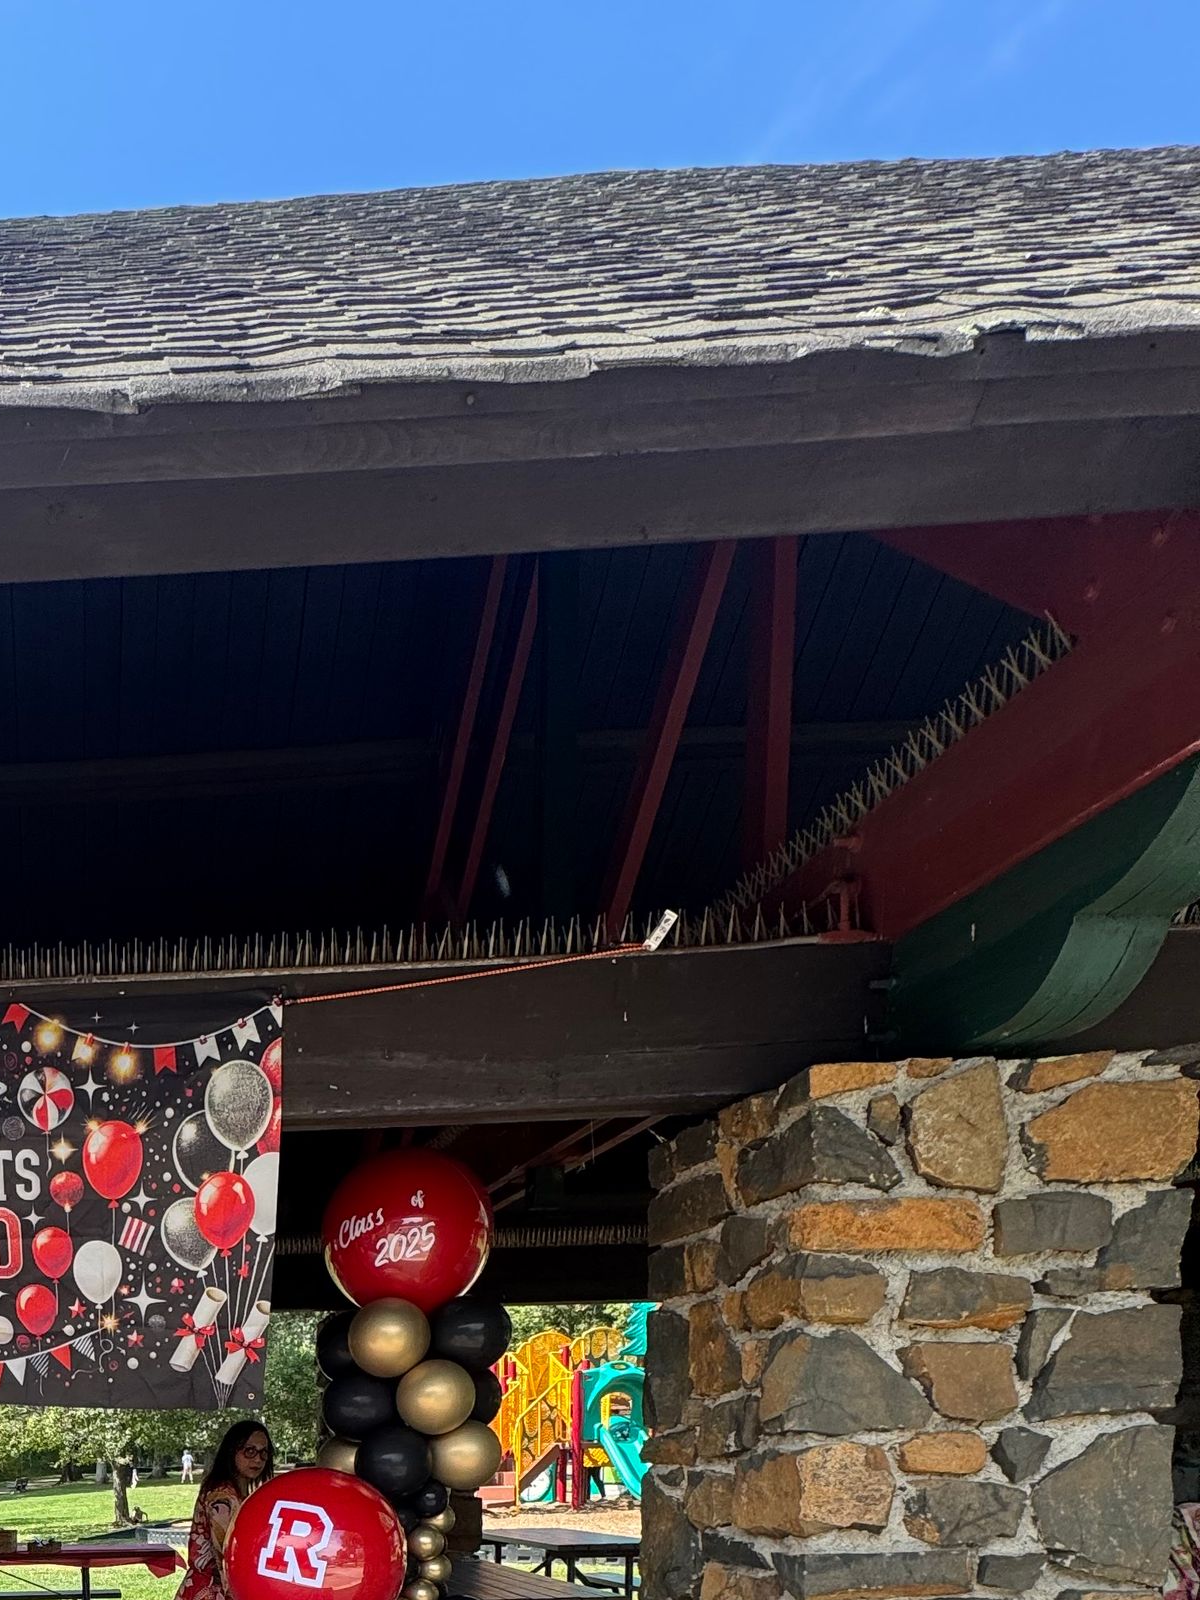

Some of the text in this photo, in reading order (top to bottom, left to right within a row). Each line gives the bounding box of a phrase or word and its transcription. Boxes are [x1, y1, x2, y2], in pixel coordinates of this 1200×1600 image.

[338, 1189, 425, 1249] Class of
[374, 1221, 436, 1268] 2025
[257, 1499, 334, 1589] R
